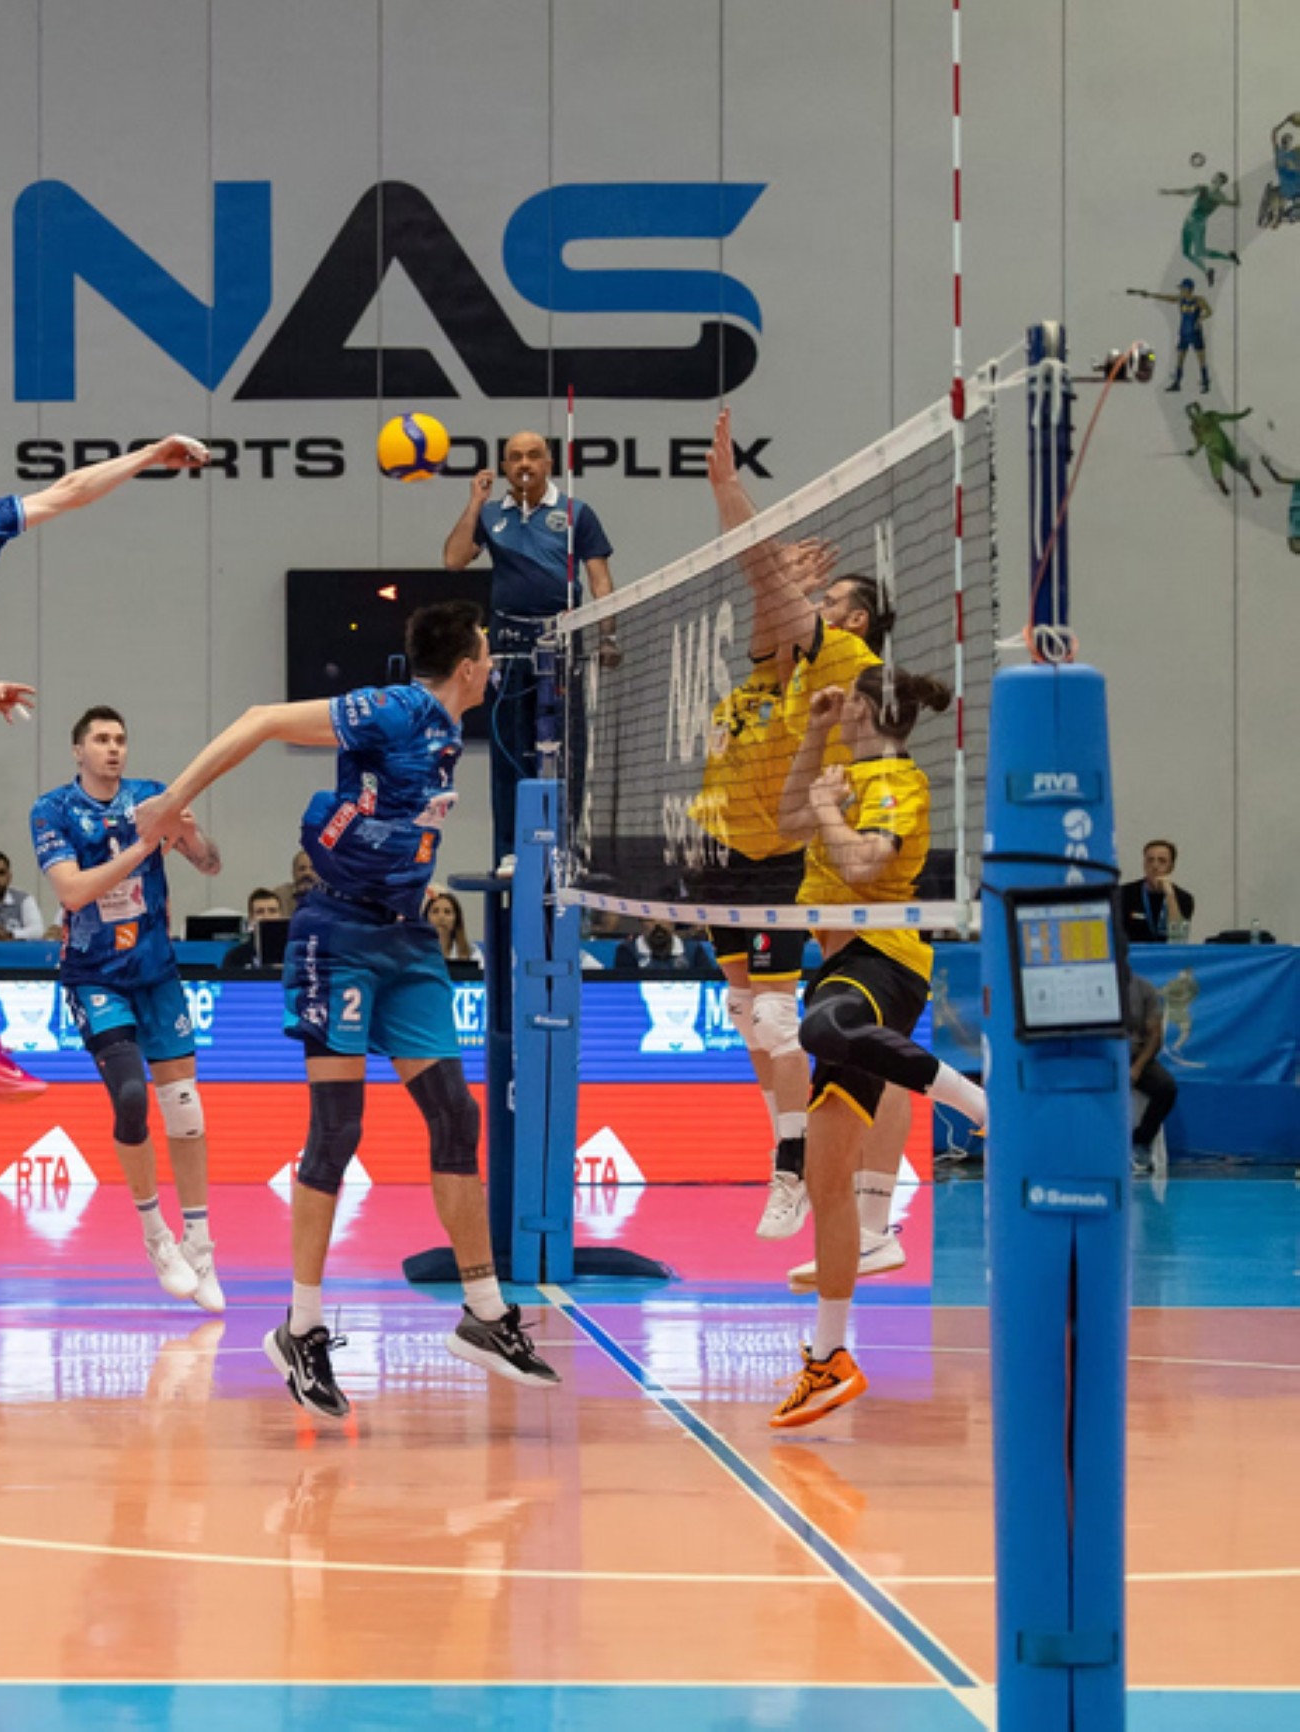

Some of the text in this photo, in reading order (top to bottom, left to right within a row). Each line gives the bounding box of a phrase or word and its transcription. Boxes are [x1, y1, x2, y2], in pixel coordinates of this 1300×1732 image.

[13, 180, 767, 402] NAS
[380, 436, 772, 479] OPLEX
[341, 987, 362, 1022] 2
[17, 1155, 71, 1185] RTA
